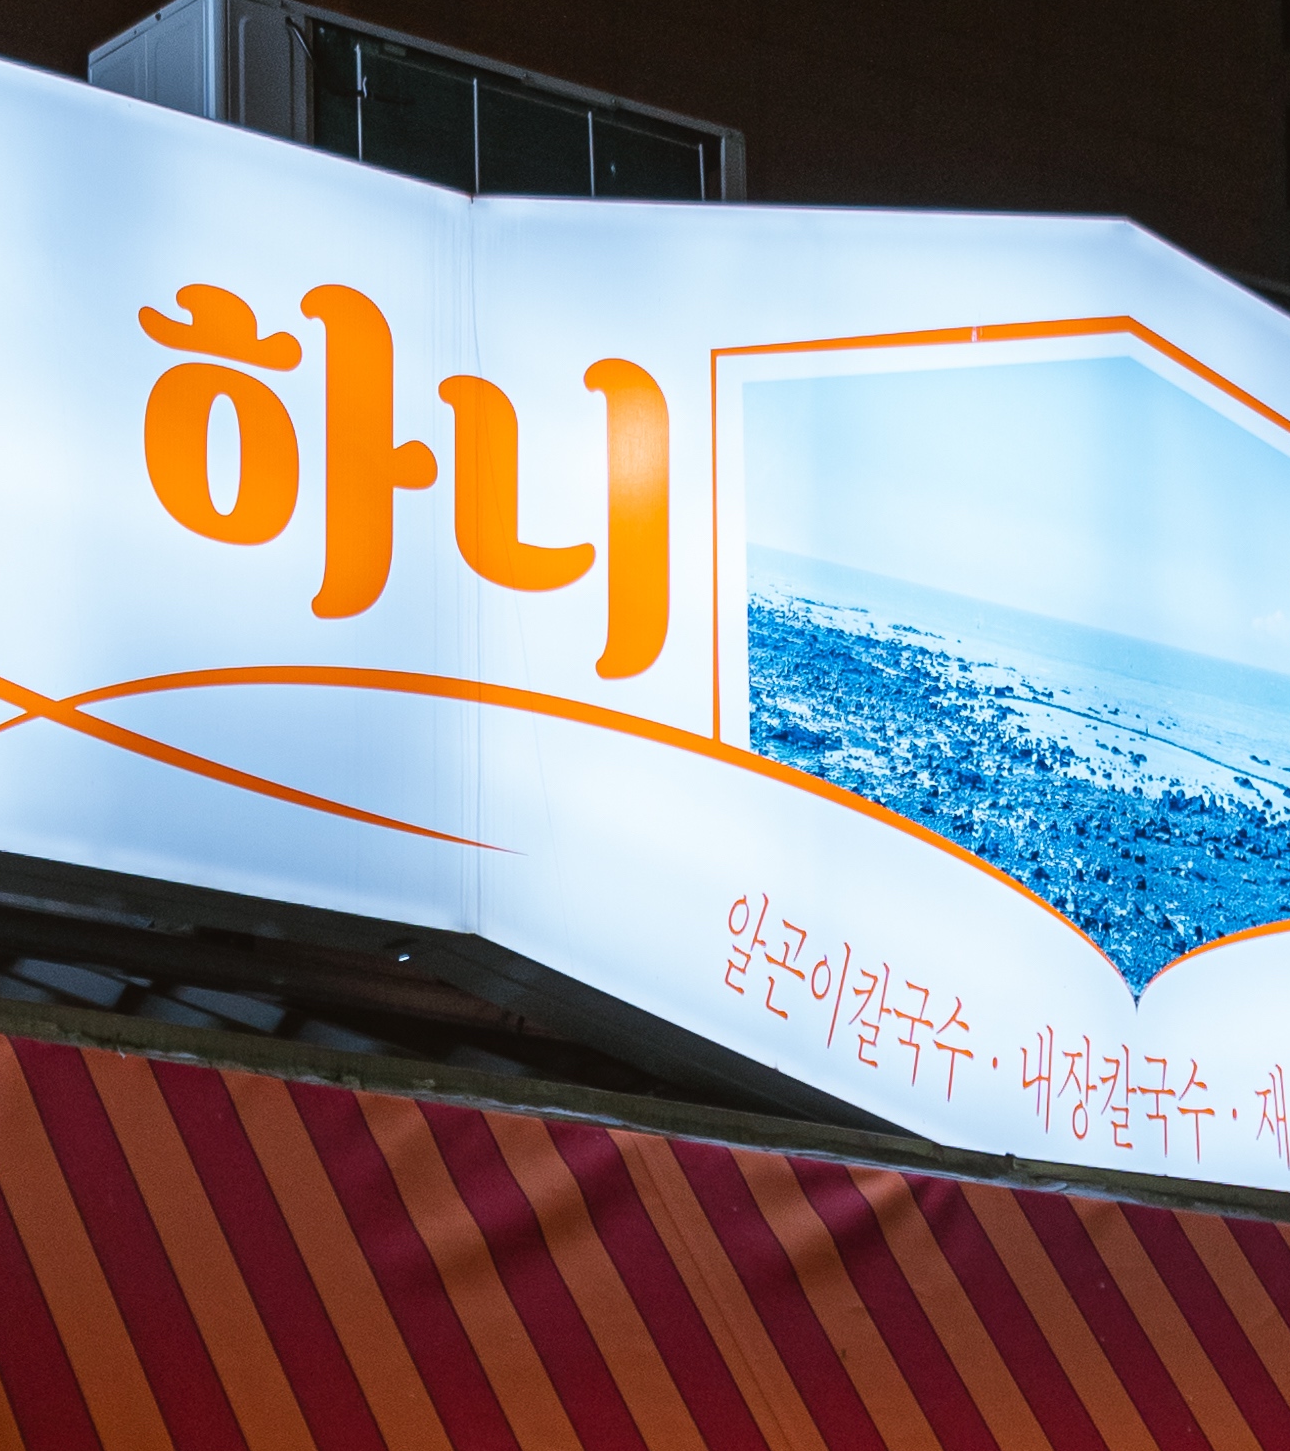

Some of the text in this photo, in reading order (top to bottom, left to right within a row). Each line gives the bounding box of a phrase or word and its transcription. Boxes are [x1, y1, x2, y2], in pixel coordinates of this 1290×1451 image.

[138, 283, 671, 681] 하니
[724, 892, 974, 1103] 알곤이칼국수
[1020, 1024, 1216, 1164] 내장칼국수
